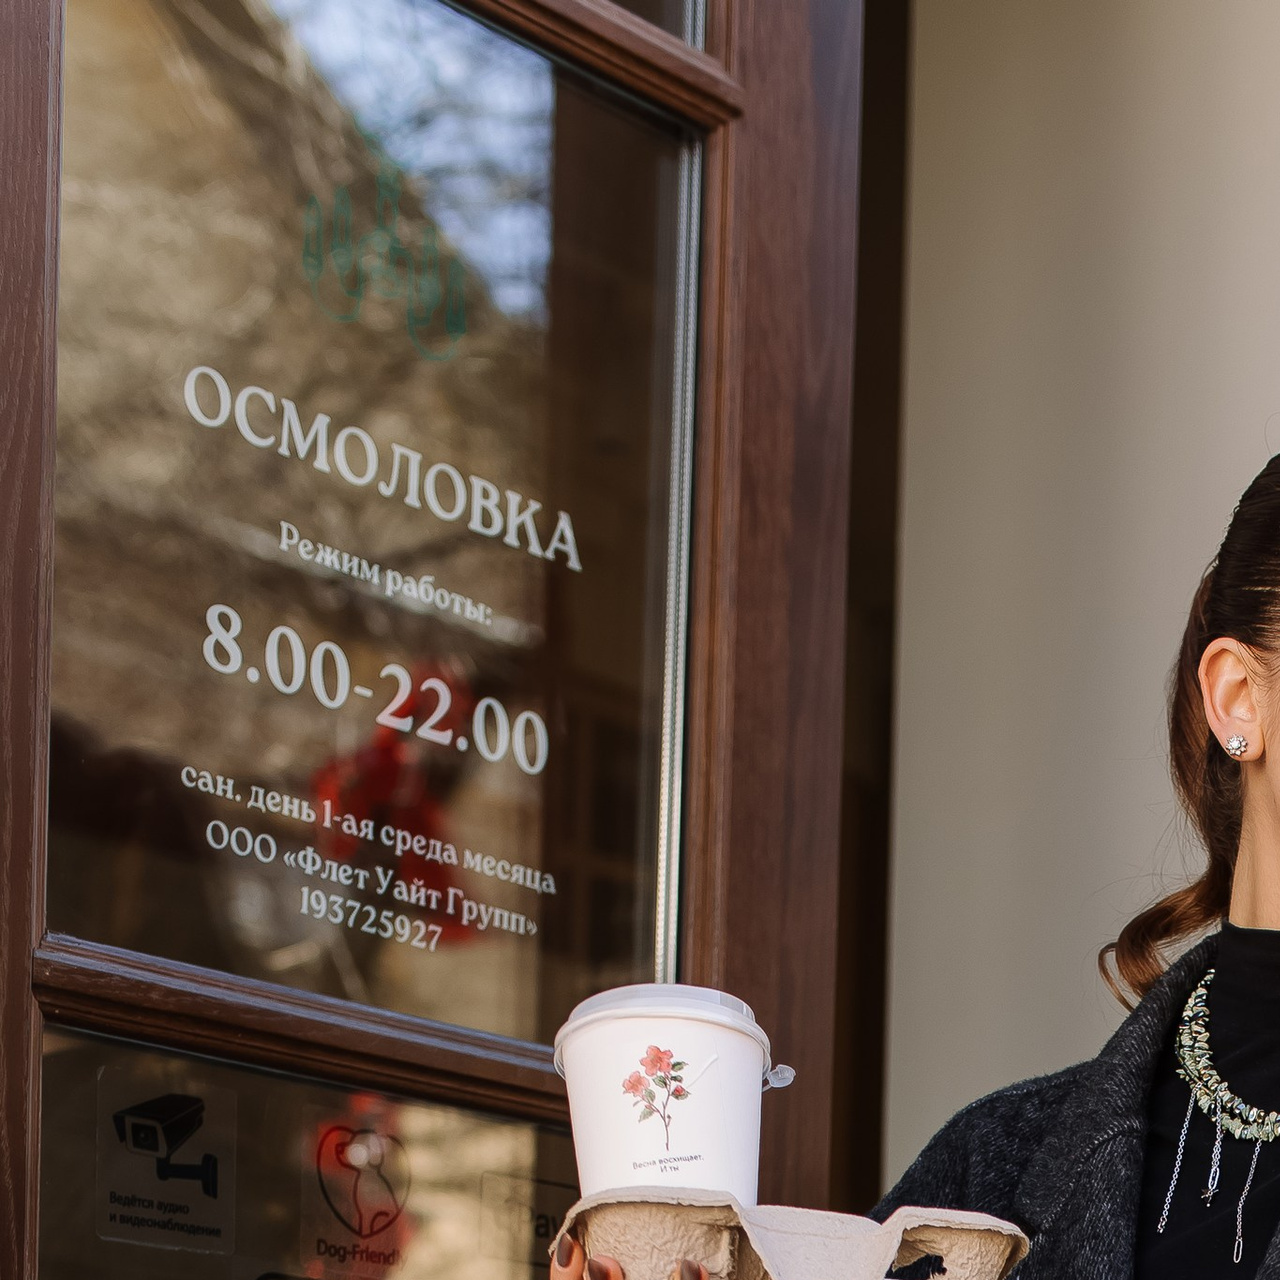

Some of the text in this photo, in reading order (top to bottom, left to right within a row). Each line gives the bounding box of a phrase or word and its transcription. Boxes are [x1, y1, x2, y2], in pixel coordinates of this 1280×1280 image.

[184, 366, 582, 571] ОСМОЛОВКА
[279, 520, 492, 626] Режим работы:
[202, 603, 549, 775] 8.00-22.00
[181, 766, 556, 894] сан. день 1-ая среда месяца
[206, 820, 538, 936] ООО «Флет Уайт Групп»
[300, 886, 442, 952] 193725927
[109, 1190, 190, 1215] Ведётся аудио
[109, 1212, 222, 1238] и видеонаблюдение
